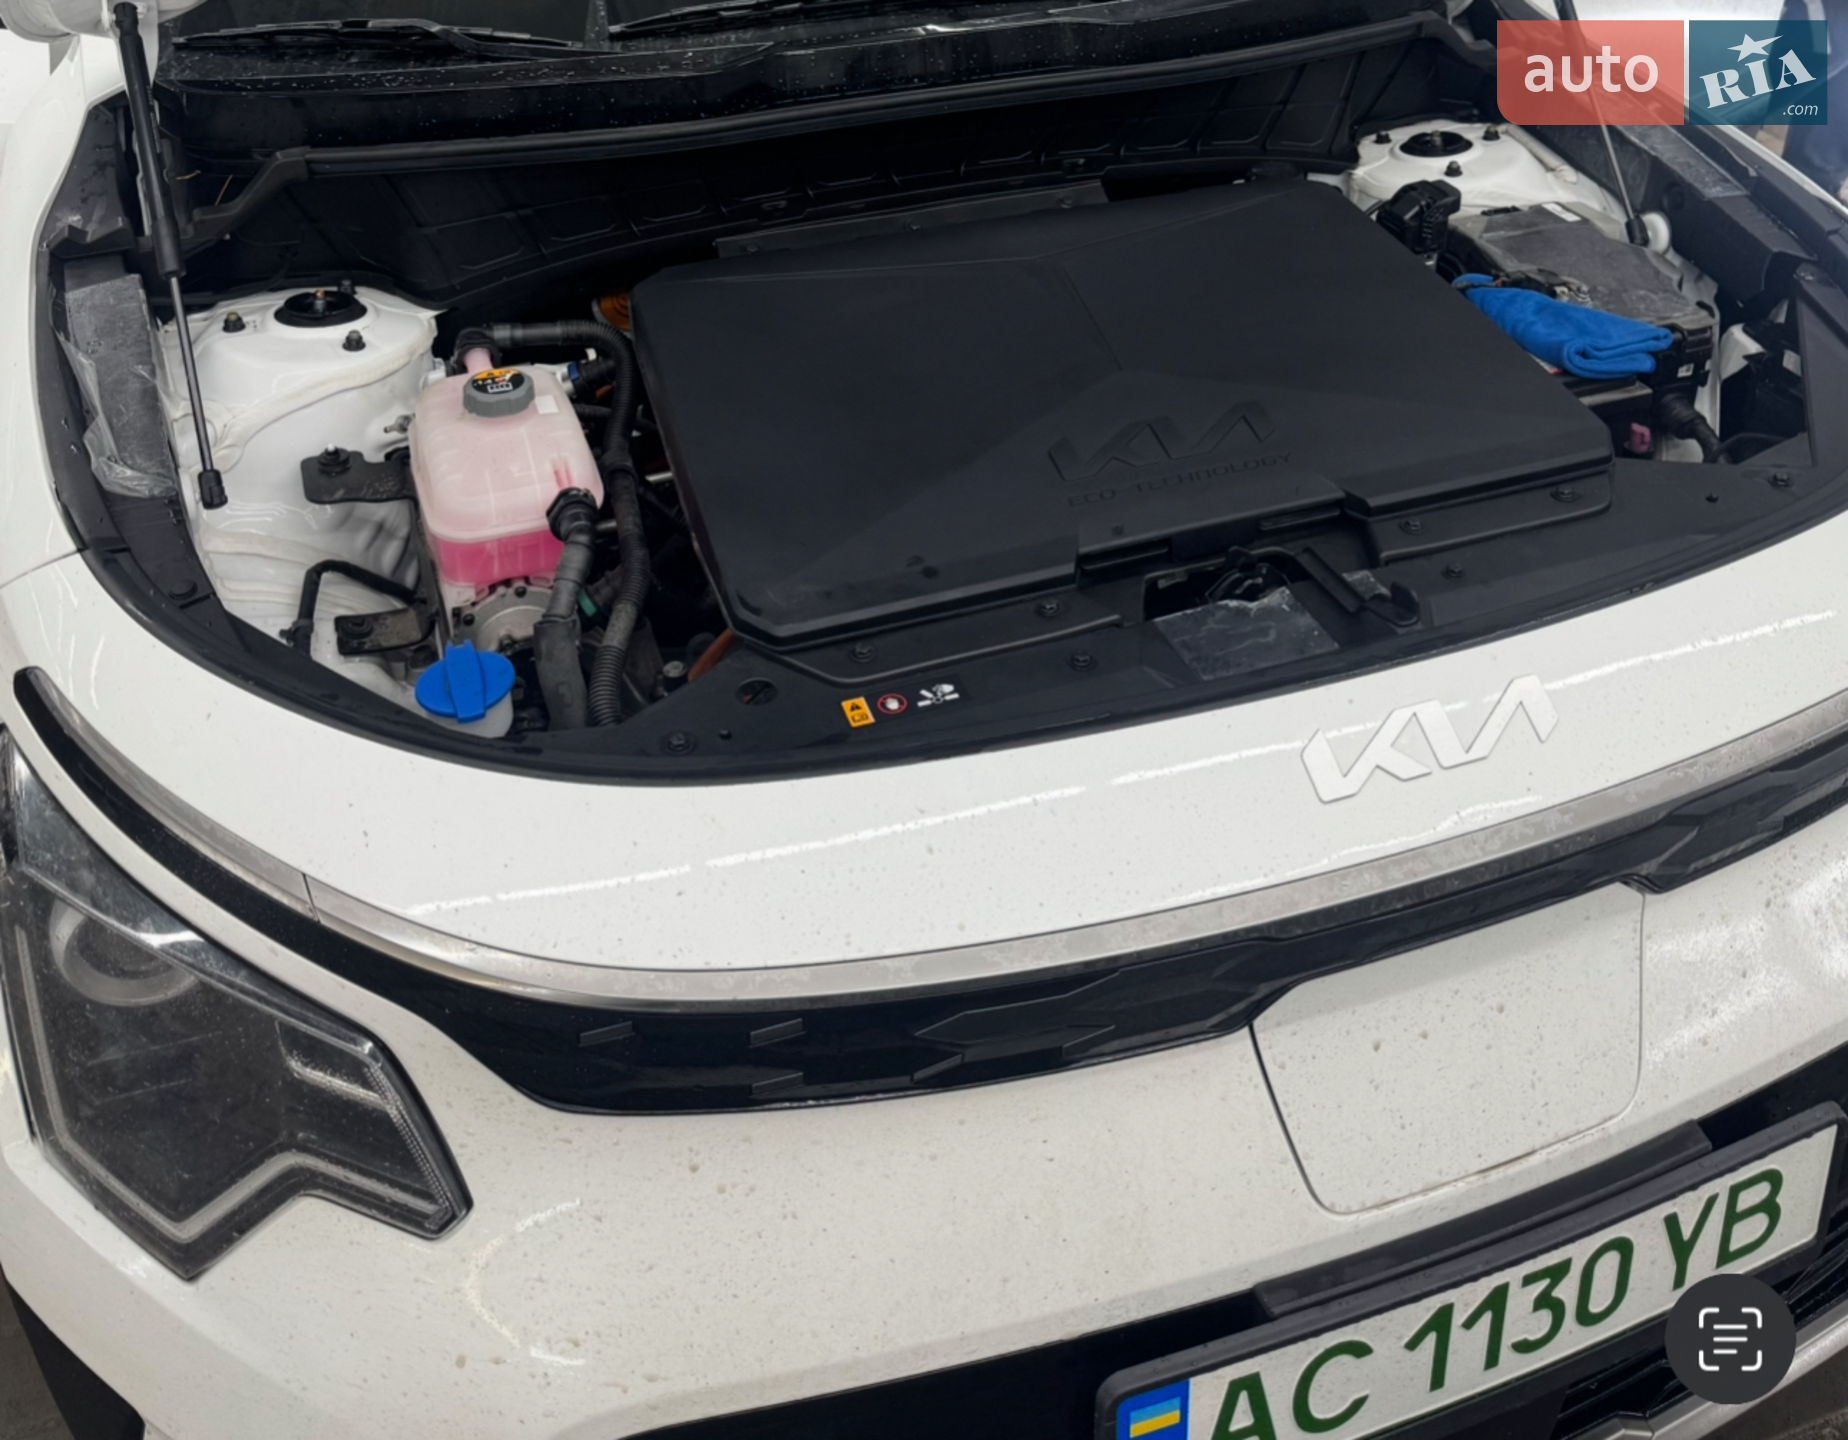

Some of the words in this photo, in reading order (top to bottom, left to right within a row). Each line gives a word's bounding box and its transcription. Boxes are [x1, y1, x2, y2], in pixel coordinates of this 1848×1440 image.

[1047, 400, 1276, 482] KIA
[1300, 675, 1559, 804] KIA
[1209, 1339, 1375, 1440] AC
[1402, 1235, 1635, 1393] 1130
[1663, 1168, 1784, 1292] YB
